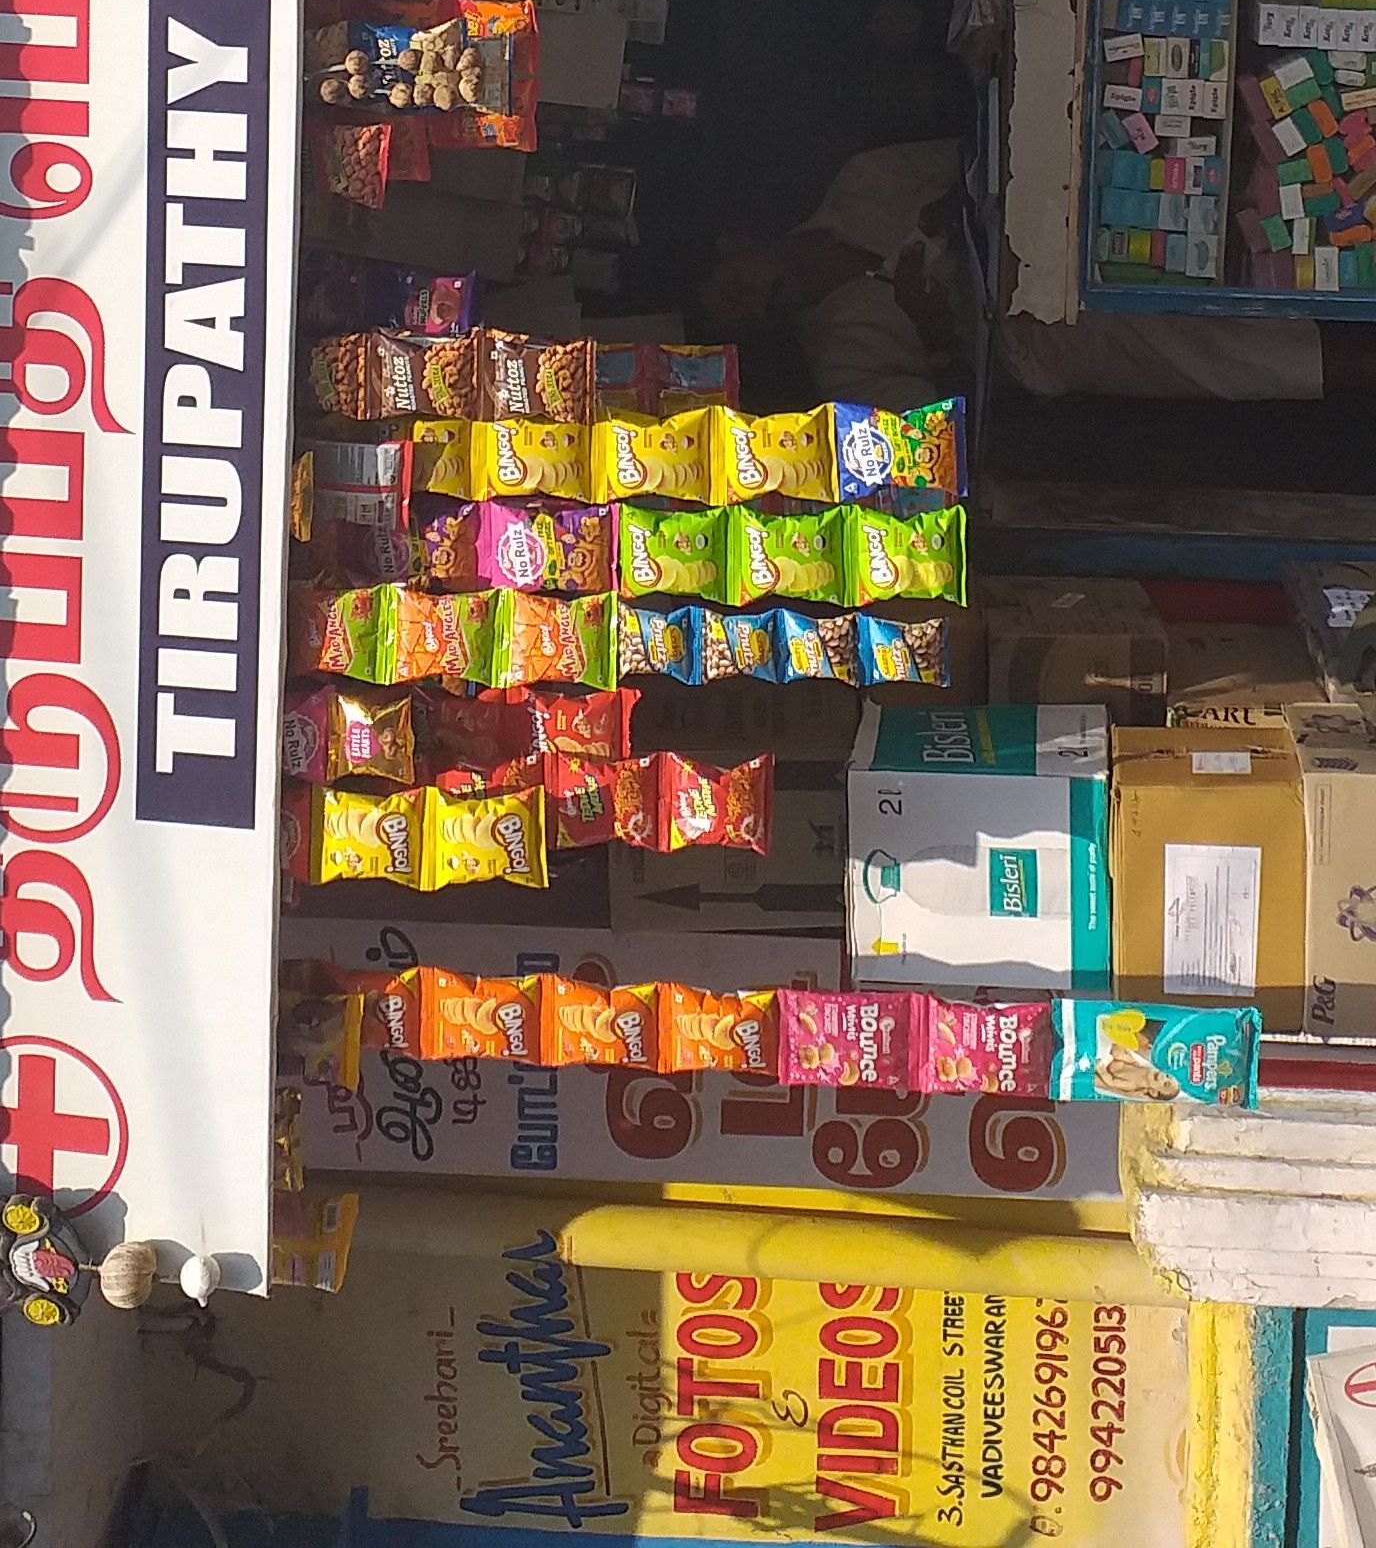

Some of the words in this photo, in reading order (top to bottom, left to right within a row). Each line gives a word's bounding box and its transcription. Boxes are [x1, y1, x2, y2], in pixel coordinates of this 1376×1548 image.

[154, 15, 251, 774] TIRUPATHY
[391, 356, 410, 410] Nuttoz
[505, 359, 524, 413] Nuttoz
[492, 422, 523, 482] BINGO!
[611, 426, 641, 484] BINGO!
[730, 427, 762, 485] BINGO!
[855, 427, 873, 456] Rulz
[863, 459, 877, 477] No
[510, 529, 526, 558] Rulz
[516, 560, 530, 579] No
[627, 524, 658, 584] BINGO!
[744, 525, 775, 585] BINGO!
[861, 525, 892, 584] BINGO!
[437, 597, 456, 641] ANGLES
[557, 602, 574, 645] ANGLES
[328, 642, 346, 669] MAD
[446, 645, 462, 674] MAD
[562, 648, 578, 676] MAD
[350, 727, 362, 758] LITTLE
[360, 728, 371, 759] HEARTS
[920, 710, 977, 764] Bisleri
[381, 814, 412, 873] BINGO!
[496, 815, 531, 874] BINGO!
[998, 852, 1024, 913] Bisleri
[1311, 974, 1337, 1026] P&G
[499, 1003, 529, 1056] BINGO!
[616, 1012, 646, 1064] BINGO!
[734, 1019, 766, 1070] BINGO!
[1204, 1034, 1227, 1090] Pampers
[941, 1290, 966, 1358] STREE
[415, 1330, 462, 1471] Sreehari
[626, 1330, 672, 1447] Digital
[673, 1271, 764, 1517] FOTOS
[815, 1281, 901, 1533] VIDEOS
[1088, 1301, 1128, 1503] 994220513
